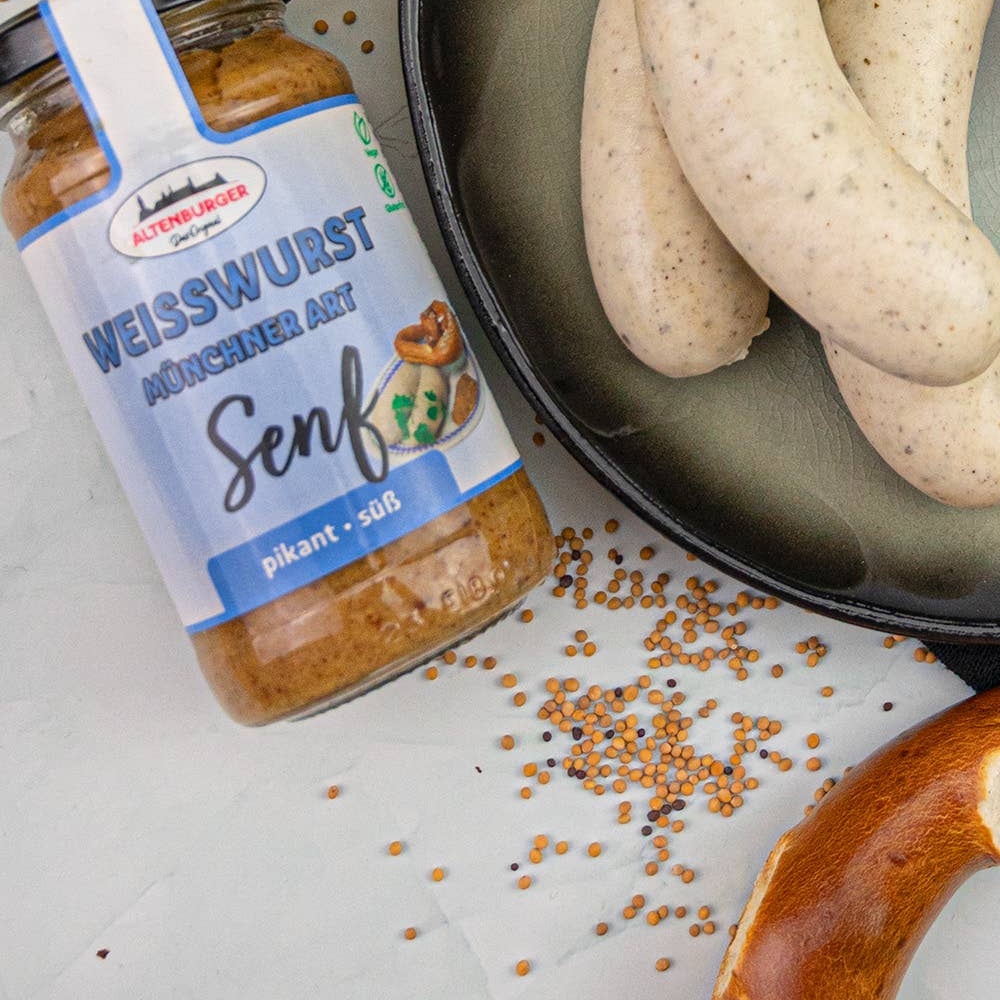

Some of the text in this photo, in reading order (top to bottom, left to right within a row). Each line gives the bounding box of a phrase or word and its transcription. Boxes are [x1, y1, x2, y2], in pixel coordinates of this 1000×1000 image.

[132, 184, 249, 247] ALTENBURGER
[82, 206, 375, 374] WEISSWURST
[142, 282, 357, 406] MÜNCHNER ART
[207, 345, 390, 512] Senf
[261, 490, 402, 579] pikant süß
